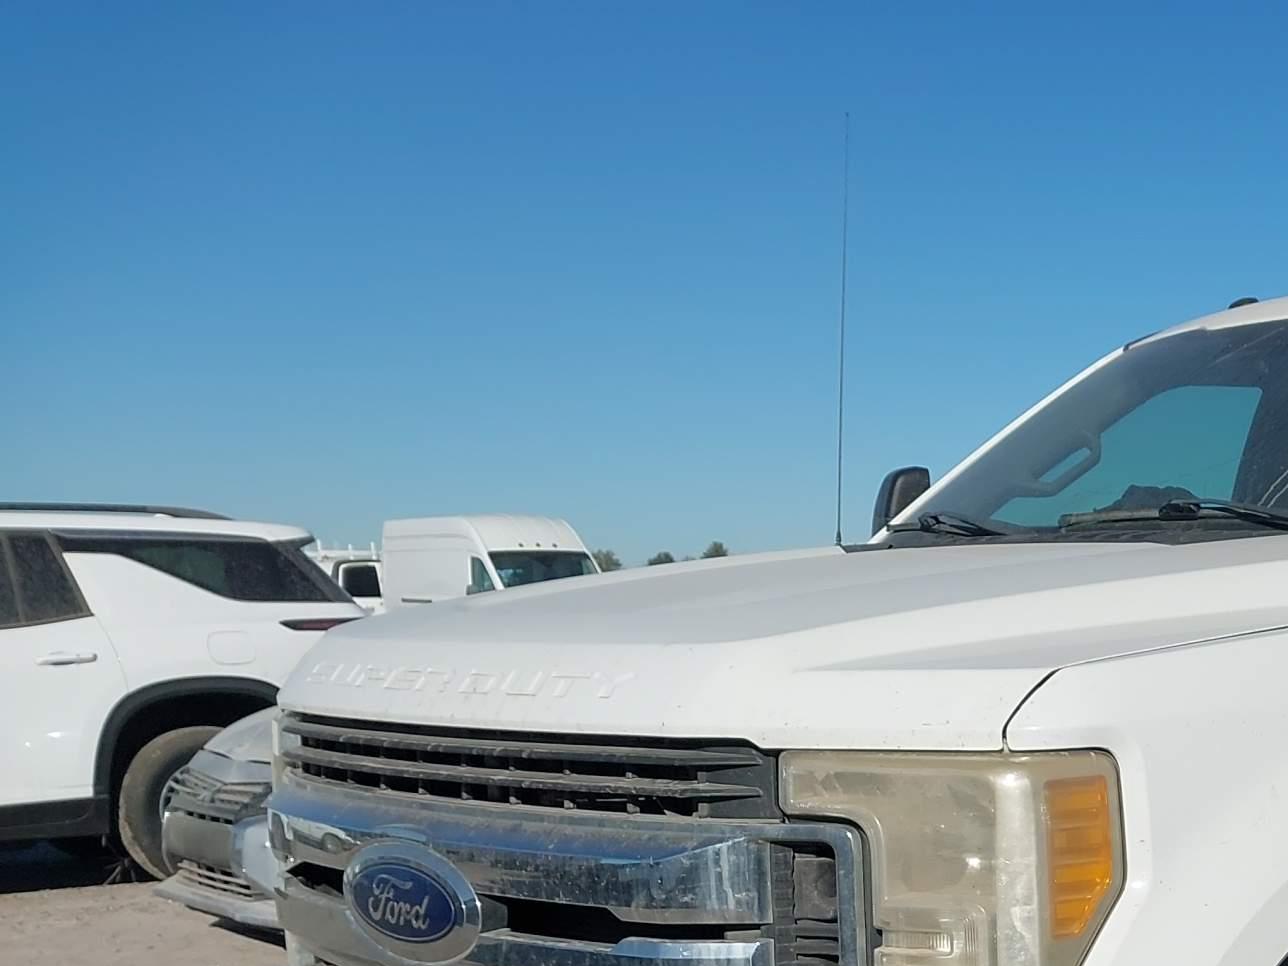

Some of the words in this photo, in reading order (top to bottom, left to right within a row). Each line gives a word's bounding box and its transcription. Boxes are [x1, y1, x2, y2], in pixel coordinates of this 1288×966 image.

[306, 663, 451, 693] SUPER
[456, 668, 637, 699] DUTY
[367, 873, 431, 931] Ford
